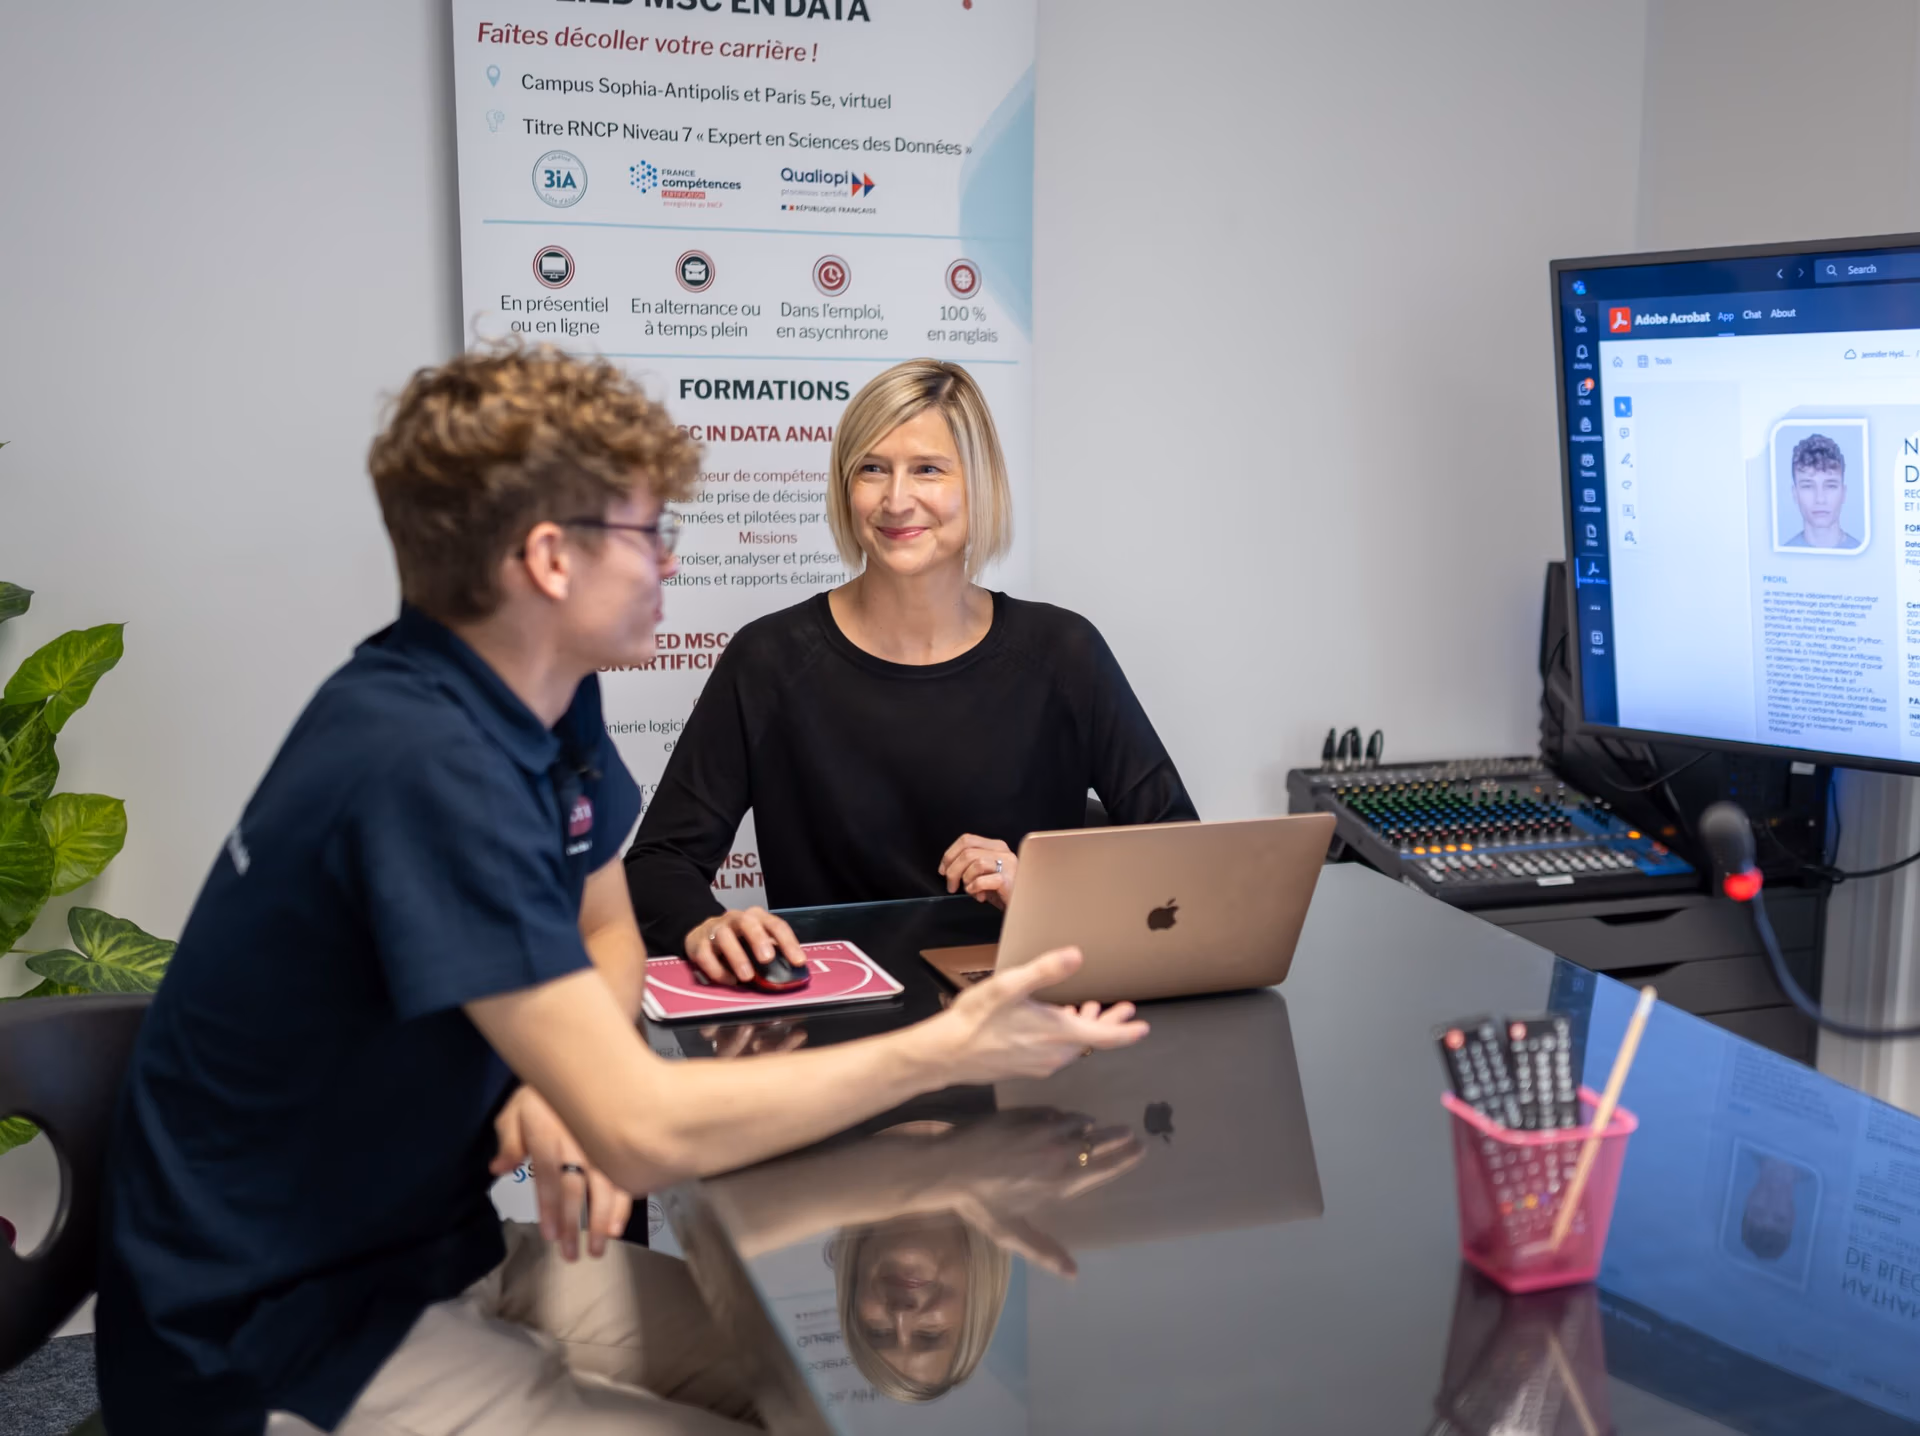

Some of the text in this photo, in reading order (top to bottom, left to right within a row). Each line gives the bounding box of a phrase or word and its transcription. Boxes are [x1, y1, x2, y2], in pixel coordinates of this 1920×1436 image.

[477, 22, 549, 46] Faîtes
[555, 26, 649, 51] décoller
[655, 35, 714, 56] votre
[719, 39, 807, 62] carrière
[521, 74, 892, 110] Campus Sophia-Antipolis et Paris 5e, virtuel
[523, 118, 564, 136] Titre
[568, 120, 619, 138] RNCP
[623, 123, 679, 142] Niveau
[682, 127, 693, 143] 7
[708, 128, 762, 147] Expert
[765, 134, 785, 147] en
[788, 131, 860, 152] Sciences
[862, 136, 891, 153] des
[895, 137, 963, 156] Données
[544, 169, 577, 189] 3iA
[661, 168, 696, 177] FRANCE
[780, 167, 849, 187] Qualiopi
[661, 178, 742, 190] compétences
[1847, 264, 1877, 275] Search
[500, 295, 609, 314] En présentiel
[631, 298, 761, 316] En alternance ou
[780, 302, 885, 322] Dans l'emploi,
[939, 306, 987, 322] 100 %
[1634, 311, 1735, 326] Adobe Acrobat App
[1742, 309, 1762, 320] Chat
[1770, 308, 1797, 319] About
[510, 318, 600, 337] ou en ligne
[644, 320, 748, 339] à temps plein
[776, 326, 796, 339] en
[927, 326, 999, 345] en anglais
[679, 378, 850, 401] FORMATIONS
[706, 425, 727, 442] IN
[730, 425, 781, 442] DATA
[733, 469, 751, 482] de
[696, 489, 714, 503] de
[717, 490, 750, 506] prise
[753, 489, 770, 503] de
[727, 512, 742, 524] et
[744, 510, 797, 525] pilotées
[799, 513, 821, 525] par
[738, 531, 798, 545] Missions
[679, 552, 722, 567] roiser,
[724, 552, 780, 567] analyser
[783, 553, 797, 565] et
[714, 573, 729, 586] et
[731, 573, 788, 588] rapports
[790, 571, 846, 585] éclairant
[685, 632, 730, 649] MSC
